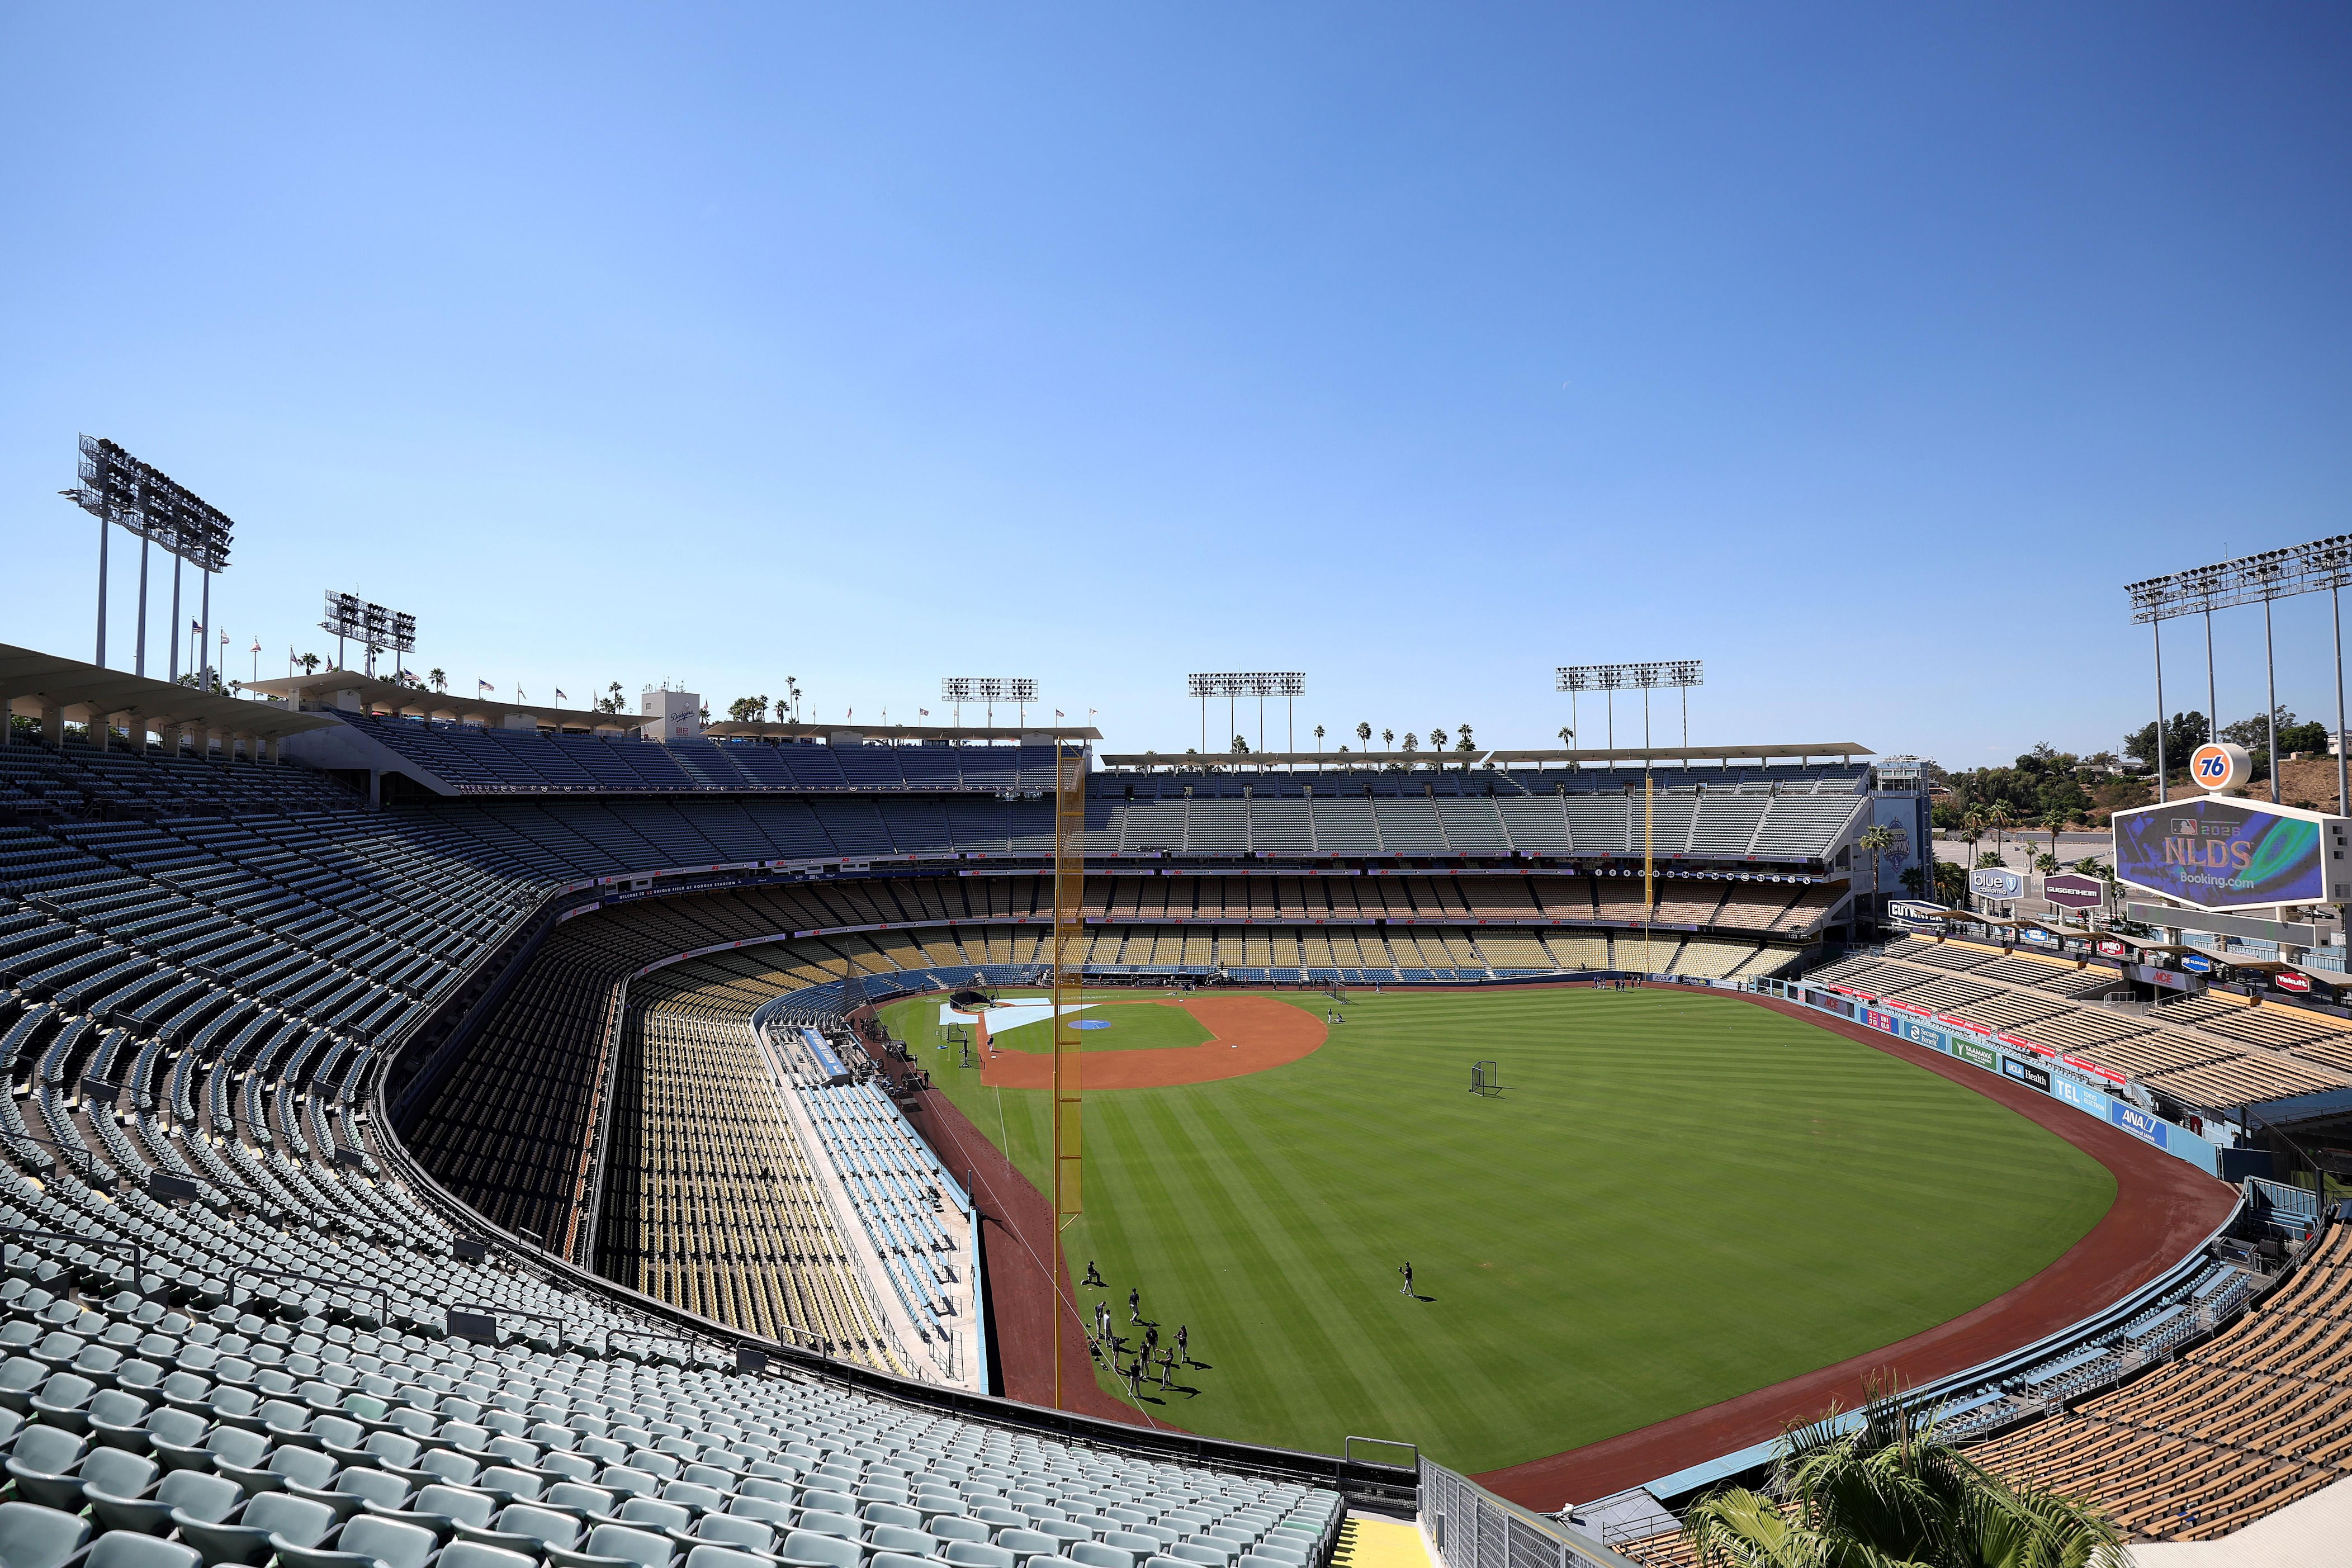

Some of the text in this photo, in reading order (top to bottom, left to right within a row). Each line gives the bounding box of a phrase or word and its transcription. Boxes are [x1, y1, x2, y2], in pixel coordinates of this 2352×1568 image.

[671, 710, 694, 722] Dodgers
[2200, 756, 2225, 776] 76
[2165, 837, 2251, 869] NLDS
[1974, 873, 2003, 888] blue
[2180, 871, 2254, 888] Booking.com
[2047, 886, 2097, 897] GUGGENHEIM
[2102, 941, 2120, 951] JINRO
[2152, 970, 2173, 984] ACE
[2277, 975, 2307, 987] Yakult
[1824, 997, 1839, 1009] ACE
[1921, 1029, 1939, 1040] Security
[1922, 1035, 1938, 1046] Benefit
[2008, 1064, 2022, 1075] UCLA
[2025, 1069, 2046, 1086] Health
[2057, 1079, 2080, 1103] TEL
[2083, 1091, 2097, 1101] TOKYO
[2084, 1098, 2104, 1112] ELECTRON
[2122, 1109, 2144, 1129] ANA
[2122, 1122, 2139, 1135] Inspiration
[2143, 1132, 2155, 1142] JAPAN
